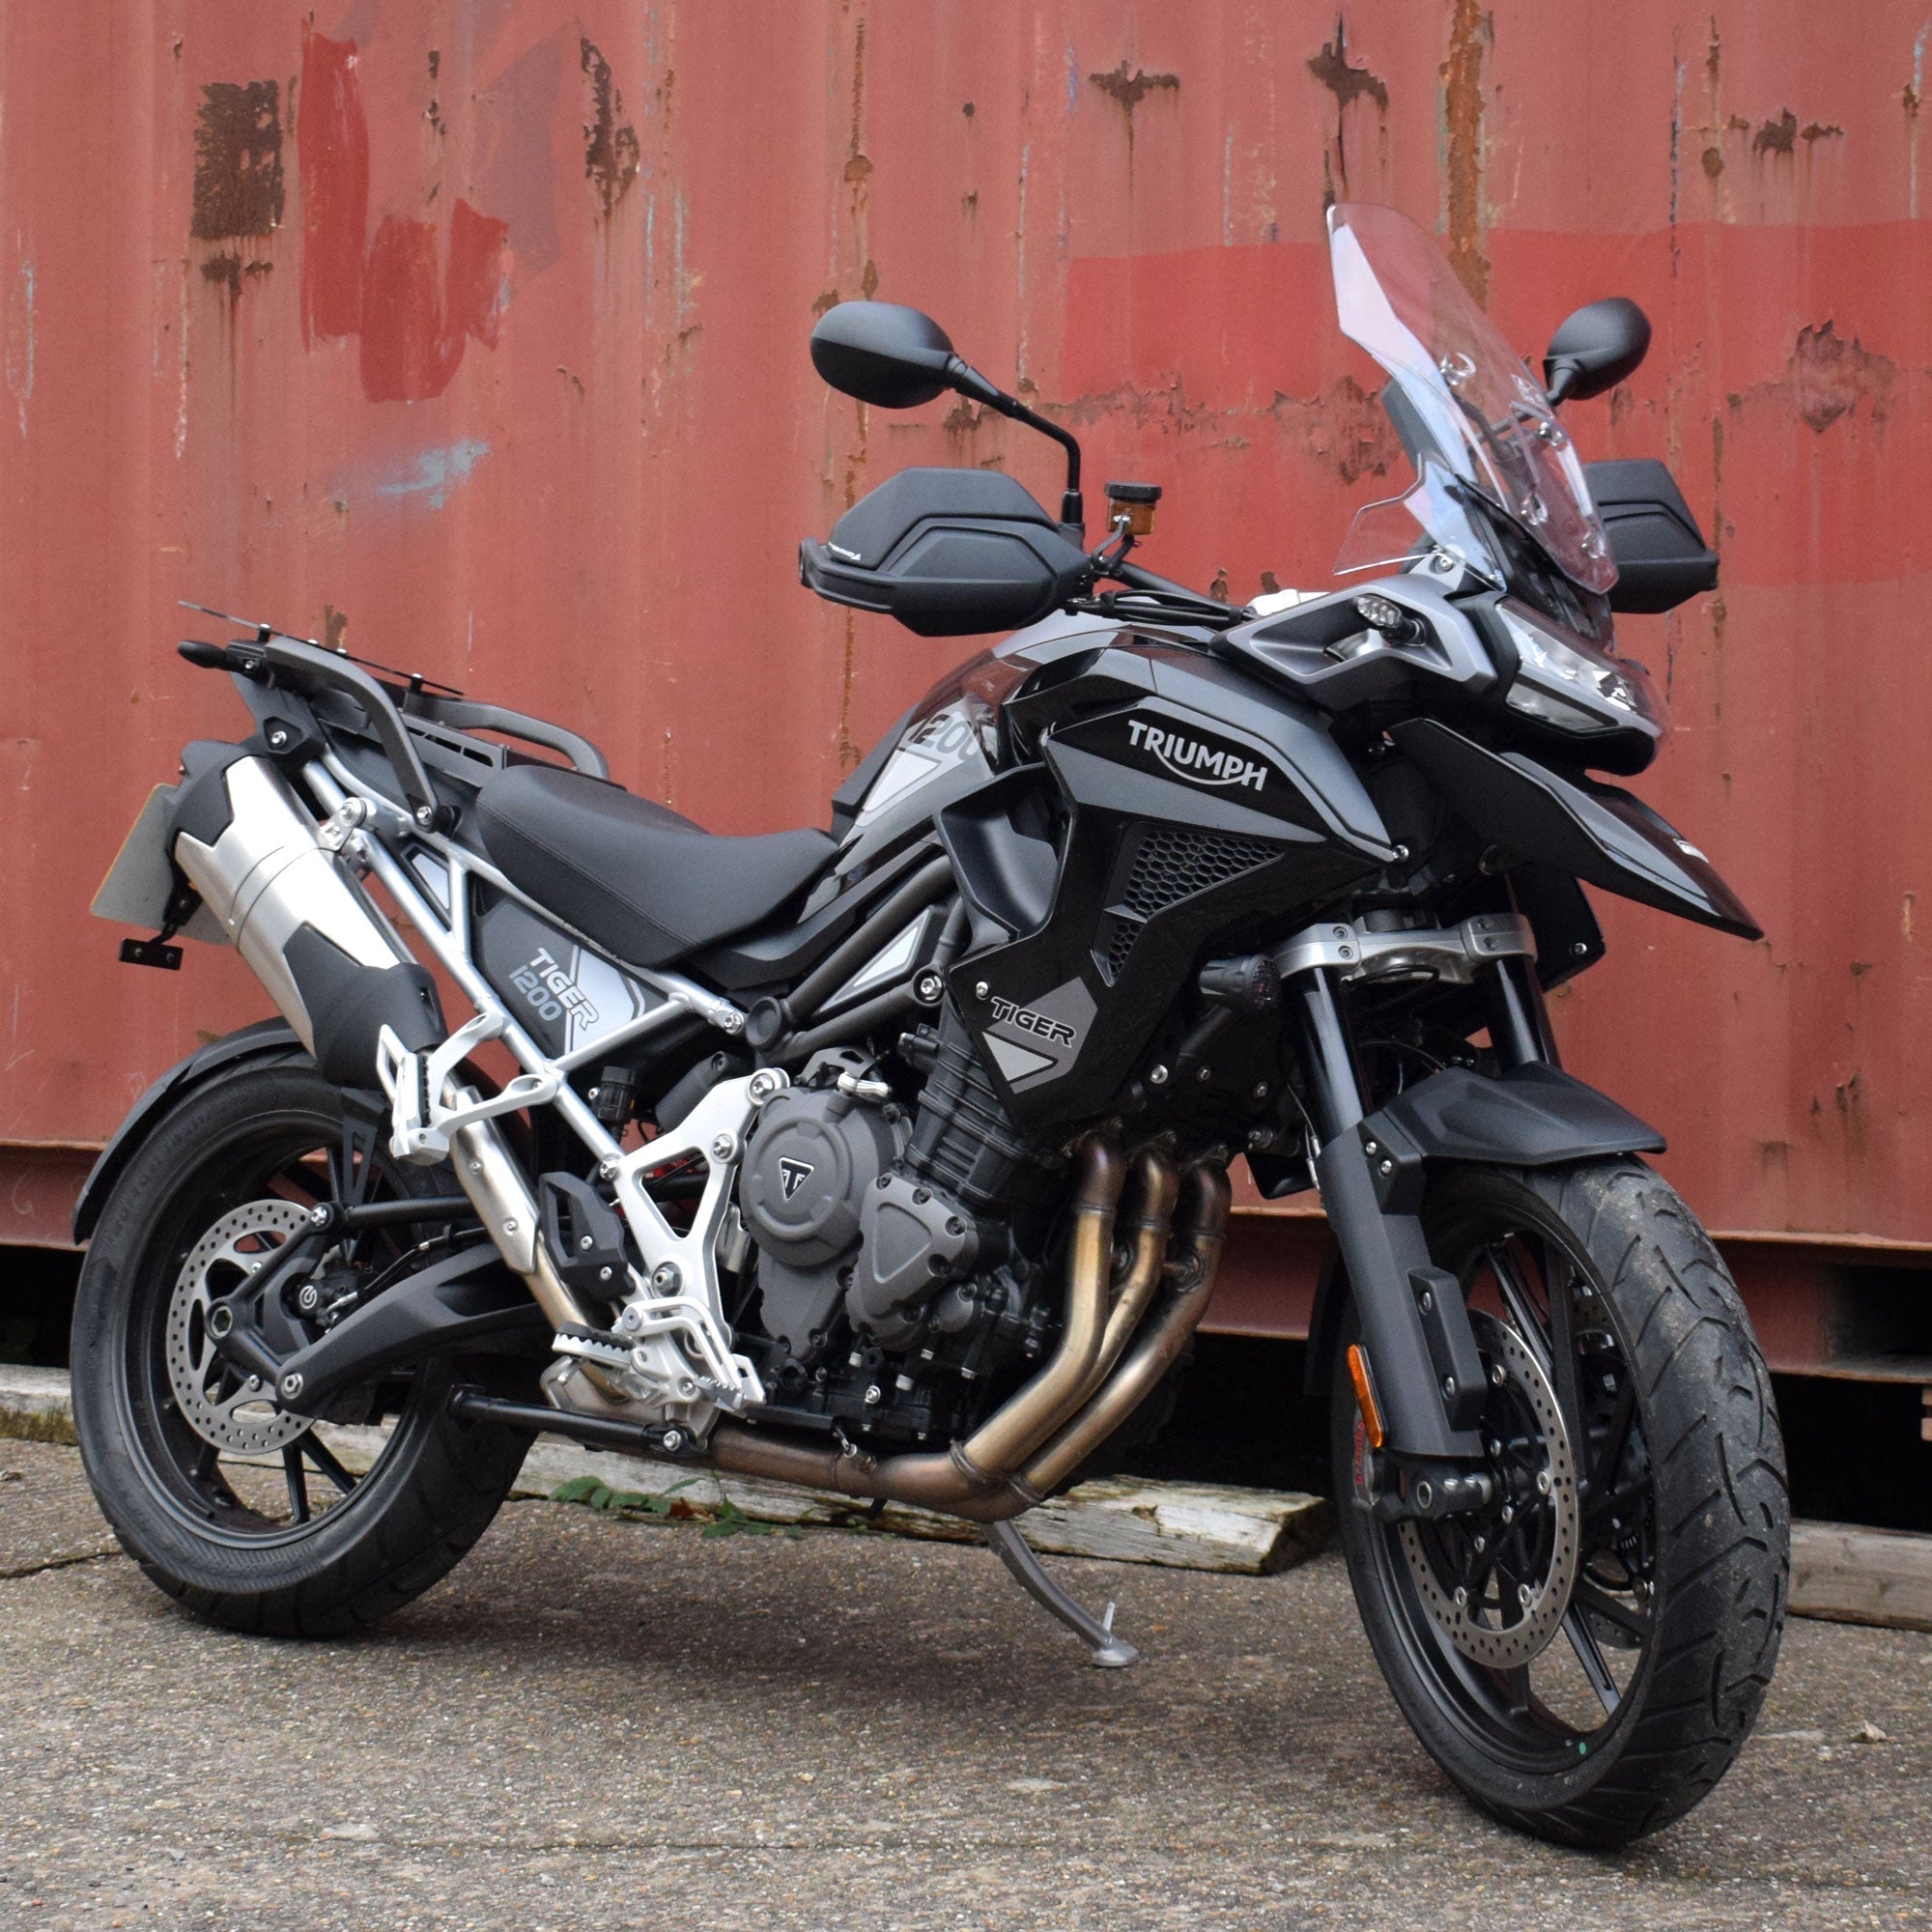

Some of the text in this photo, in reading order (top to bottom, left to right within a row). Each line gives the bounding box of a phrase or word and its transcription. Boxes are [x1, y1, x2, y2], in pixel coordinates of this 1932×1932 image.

[1128, 719, 1267, 791] TRIUMPH
[508, 964, 562, 1021] 1200
[529, 948, 599, 1031] TIGER
[990, 996, 1076, 1048] TIGER
